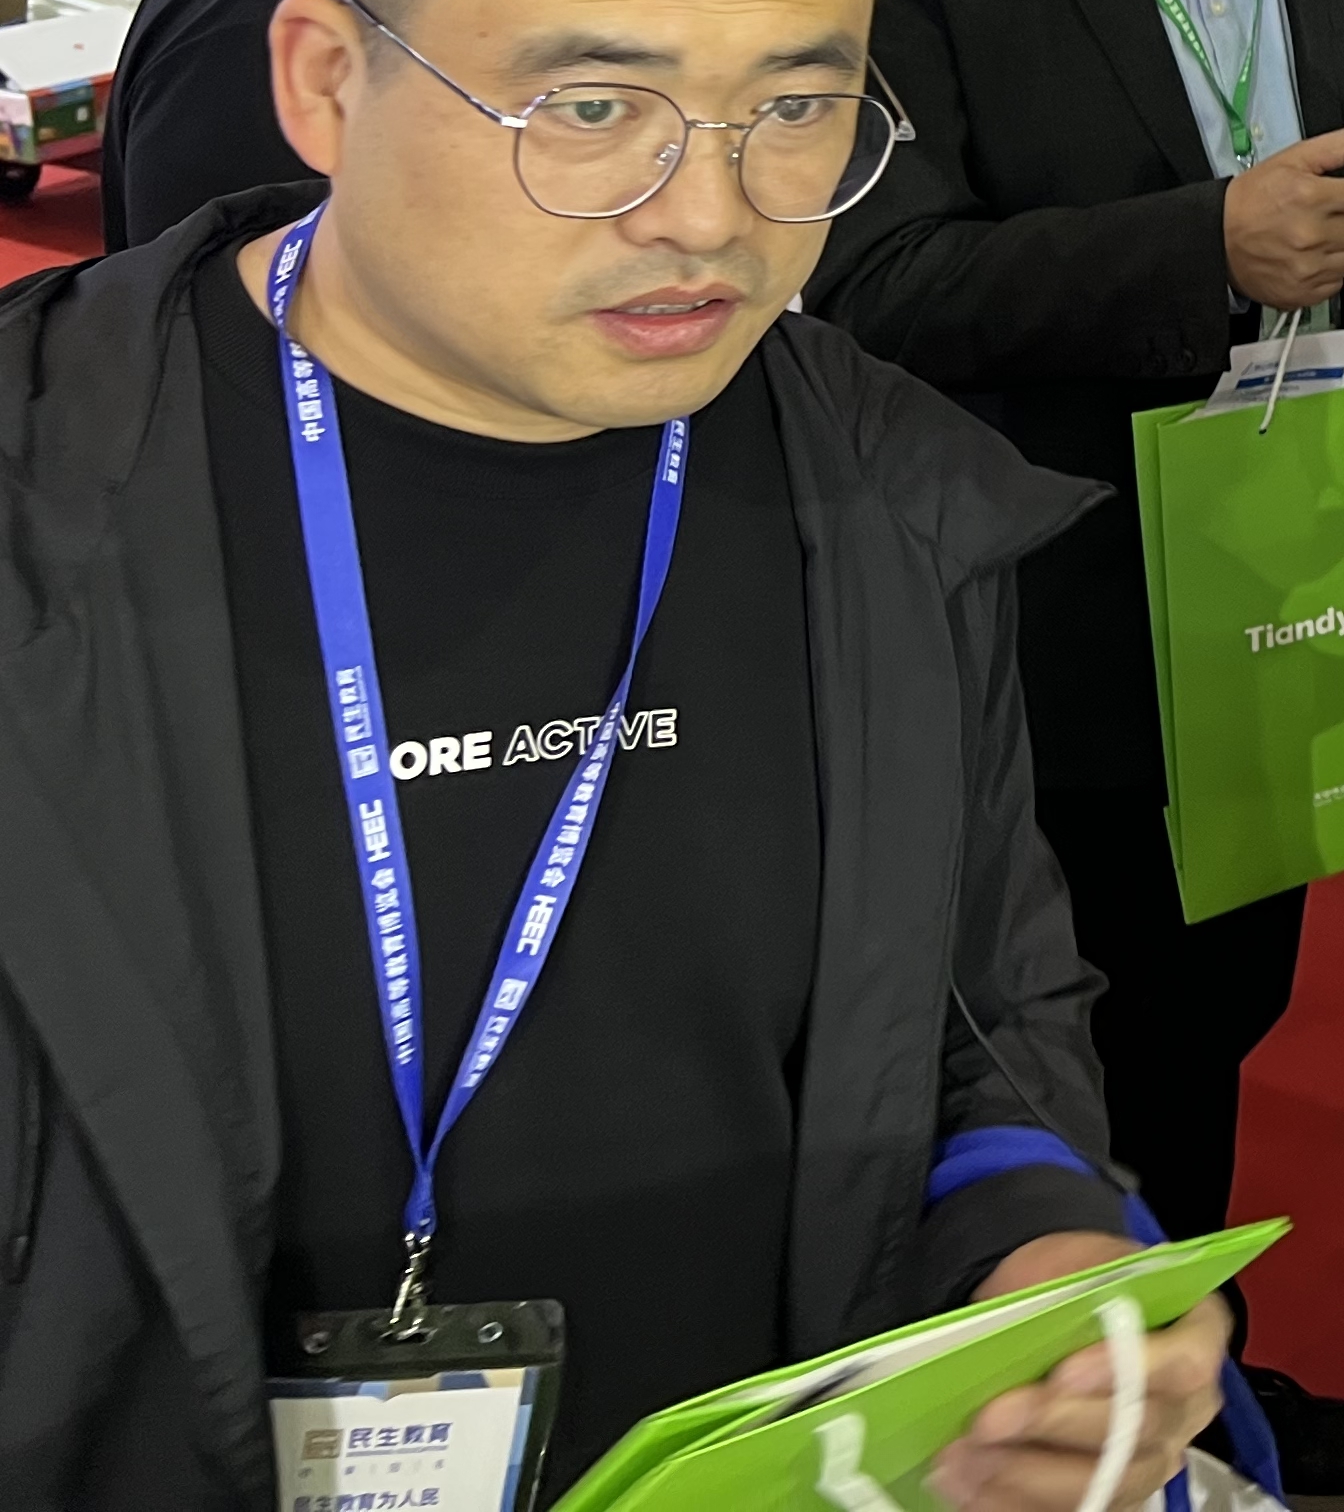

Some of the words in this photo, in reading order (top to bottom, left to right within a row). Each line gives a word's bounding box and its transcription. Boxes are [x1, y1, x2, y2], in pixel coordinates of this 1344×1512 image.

[503, 709, 677, 765] ACTVE
[359, 798, 391, 863] HEEC
[516, 894, 558, 956] HEEC
[348, 1423, 453, 1449] 民生教育
